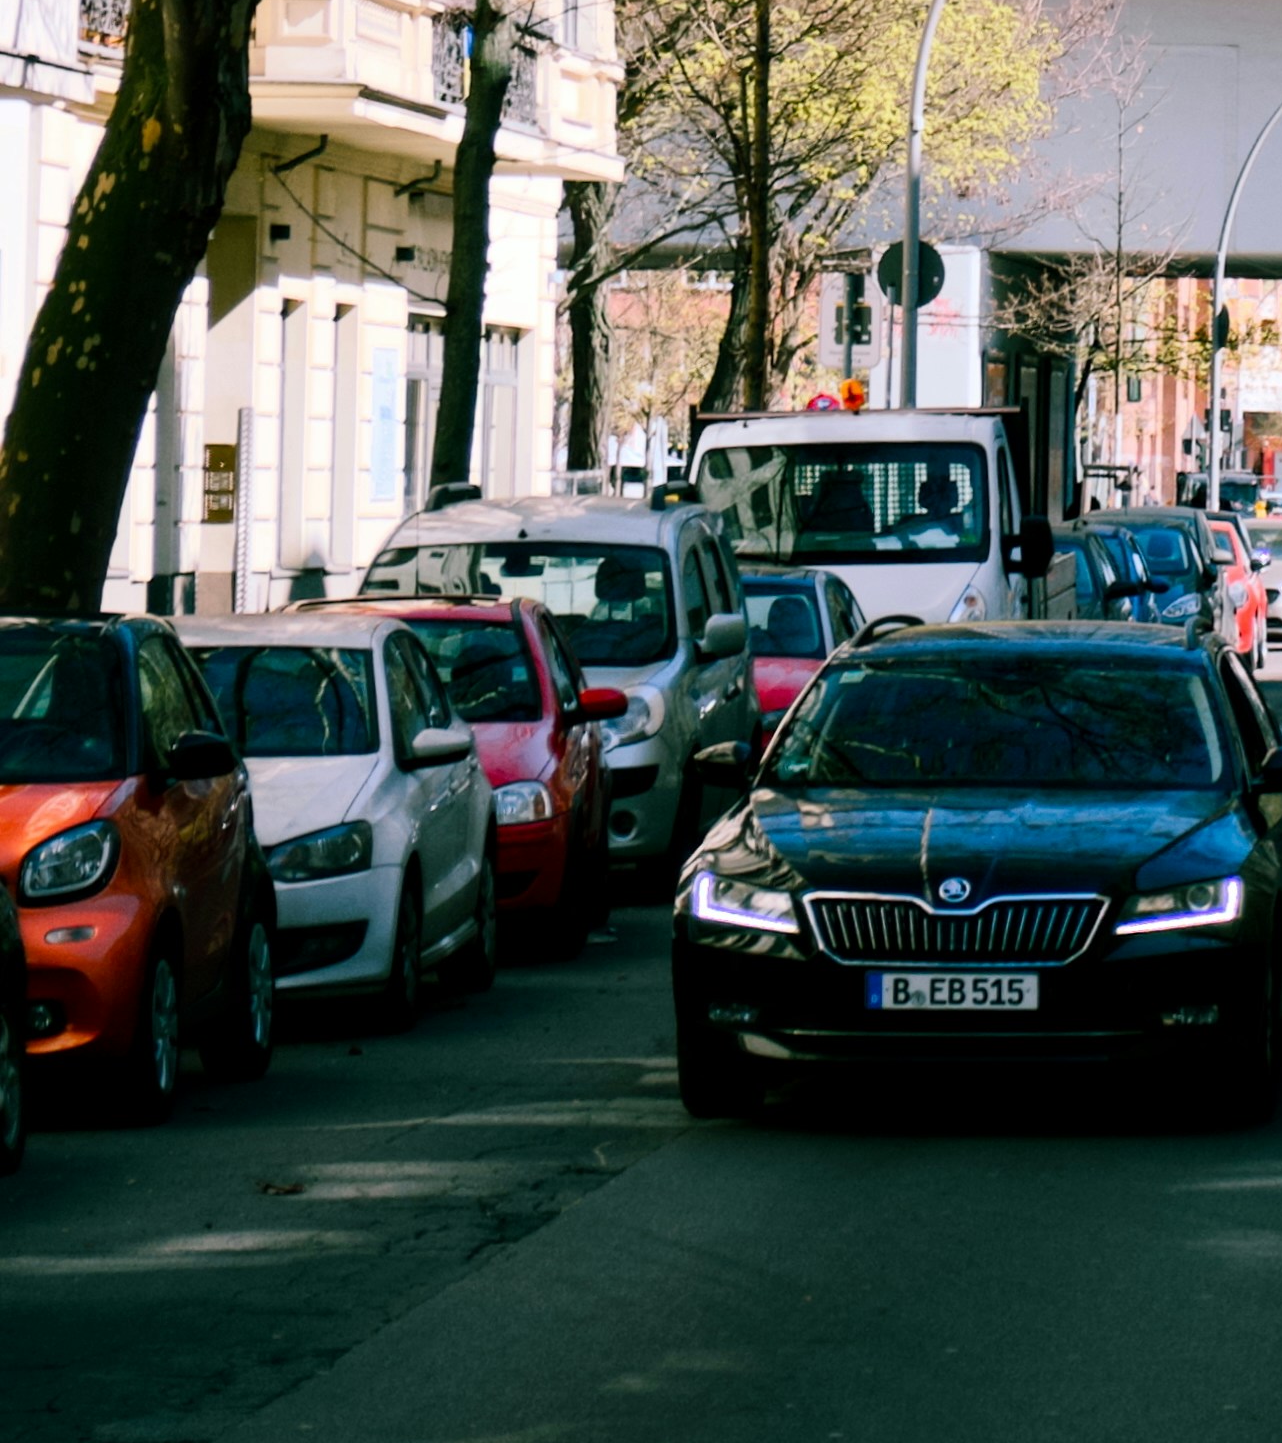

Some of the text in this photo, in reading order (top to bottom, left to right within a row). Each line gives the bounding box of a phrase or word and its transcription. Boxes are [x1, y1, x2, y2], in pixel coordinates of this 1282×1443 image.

[892, 977, 910, 1005] B
[929, 978, 966, 1005] EB
[972, 978, 1024, 1006] 515
